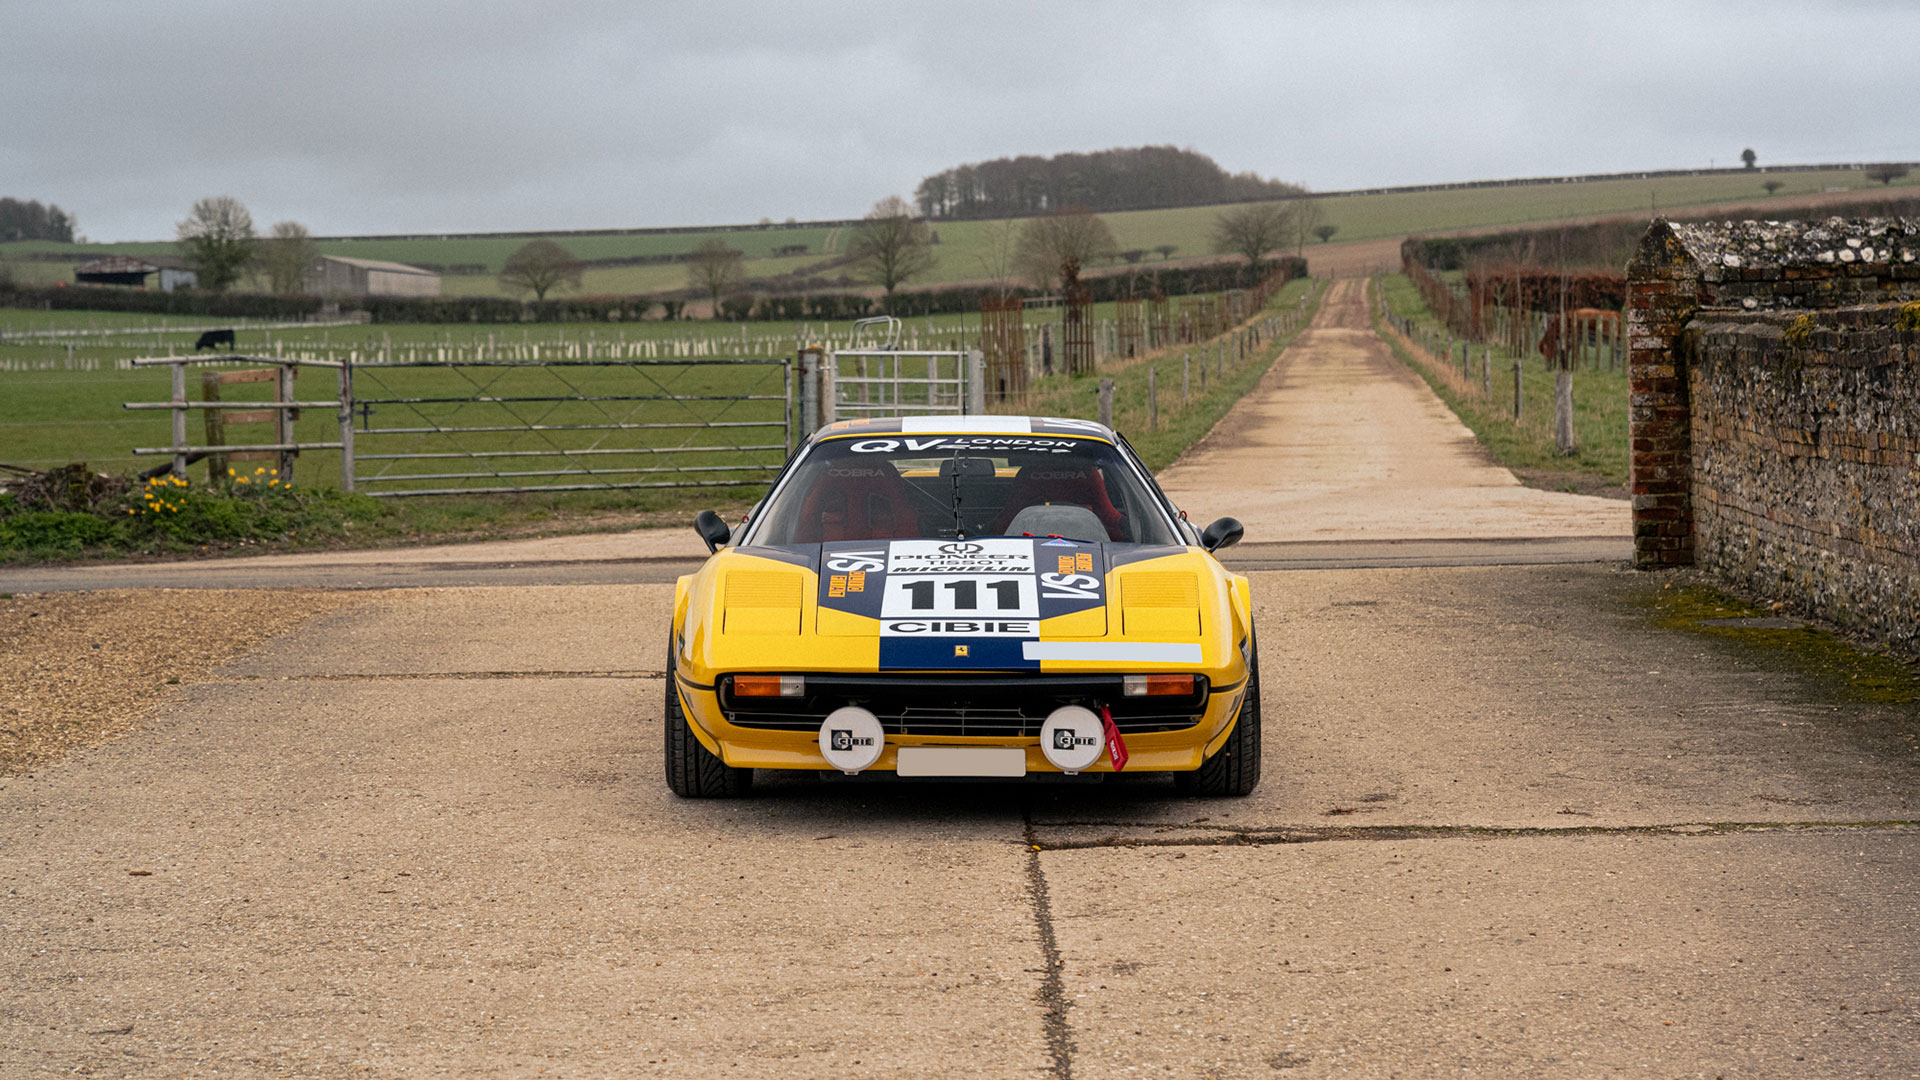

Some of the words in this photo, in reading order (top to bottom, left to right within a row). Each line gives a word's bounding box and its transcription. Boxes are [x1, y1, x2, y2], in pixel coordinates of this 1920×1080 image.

[850, 438, 948, 453] QV
[953, 438, 1077, 448] LONDON
[828, 468, 885, 477] COBRA
[1031, 471, 1087, 480] COBRA
[902, 580, 1020, 610] 111
[888, 622, 1030, 633] CIBIE
[840, 738, 872, 746] CIBIE
[1062, 737, 1094, 746] CIBIE
